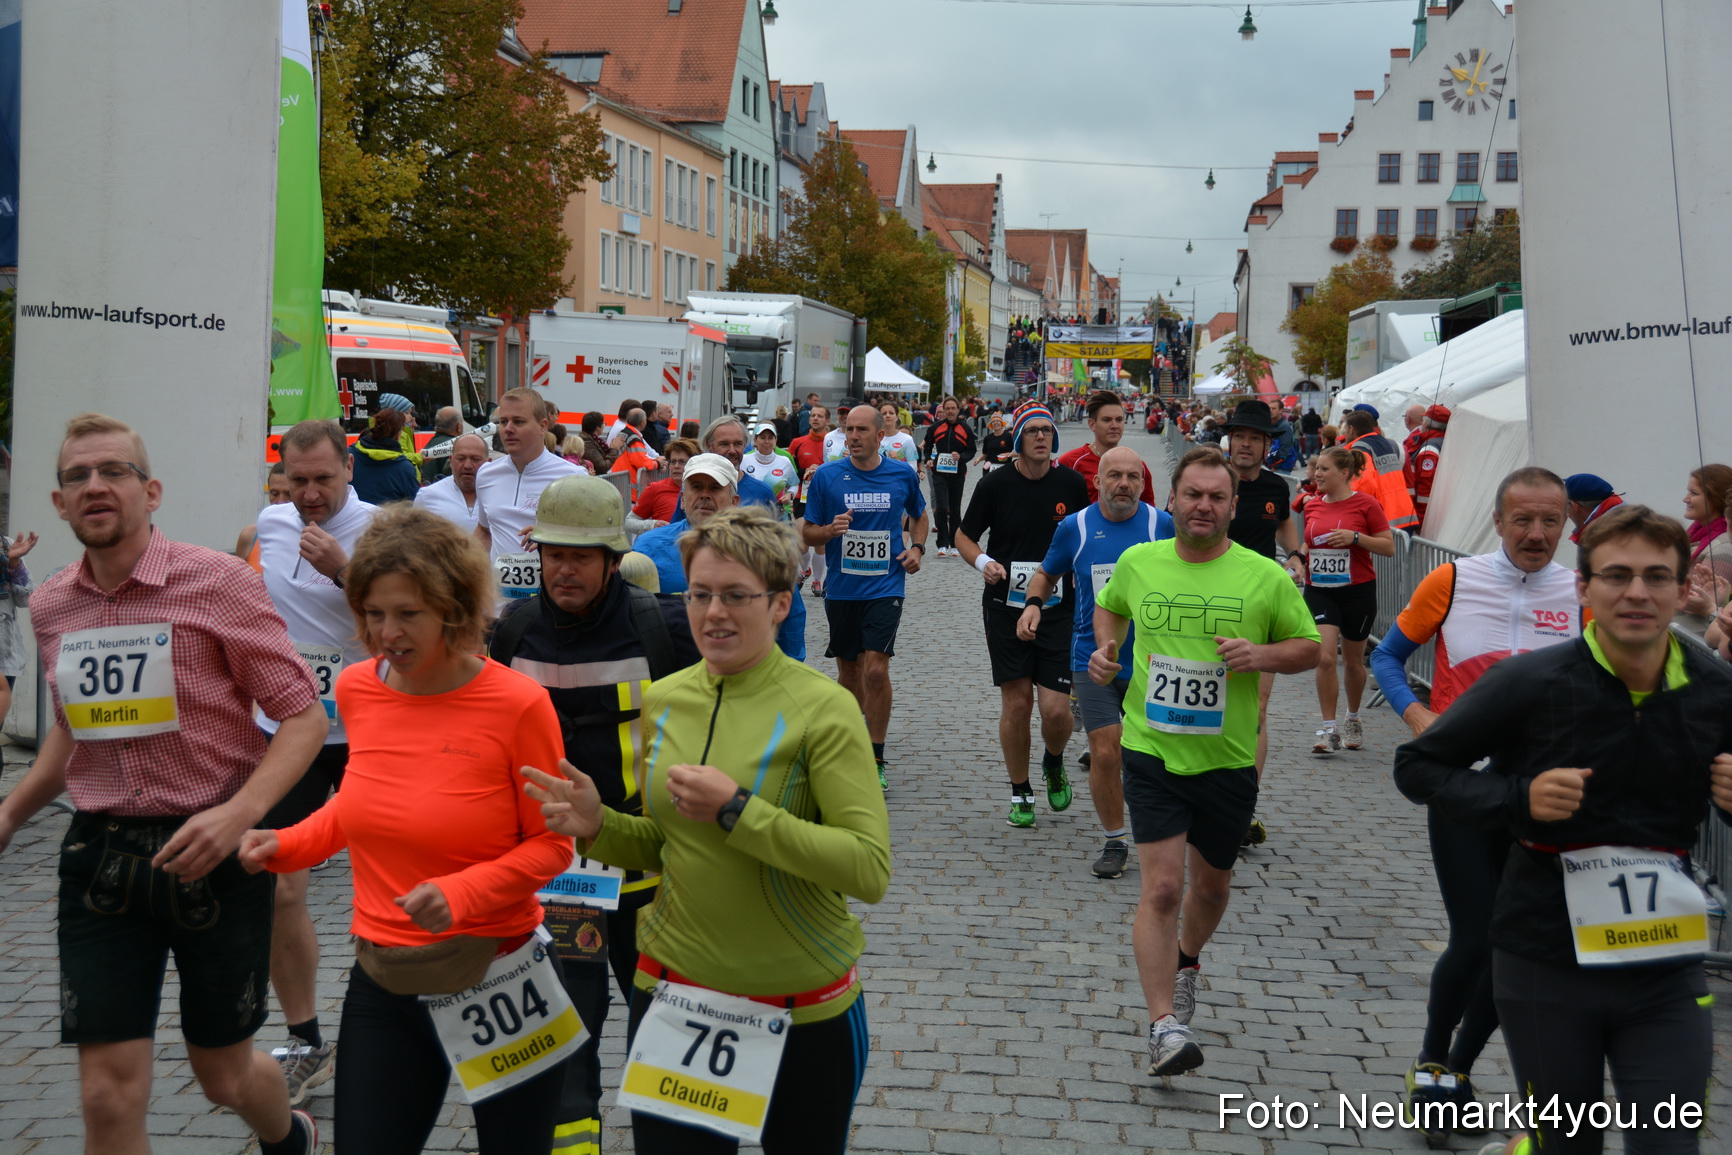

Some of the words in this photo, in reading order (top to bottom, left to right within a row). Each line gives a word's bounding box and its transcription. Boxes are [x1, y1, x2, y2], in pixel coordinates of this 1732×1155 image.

[21, 301, 226, 331] www.bmw-laufsport.de
[1569, 316, 1732, 346] www.bmw-lauf
[1080, 347, 1117, 356] START
[598, 356, 649, 367] Bayerisches
[598, 367, 622, 375] Rotes
[353, 379, 378, 393] Bayerisches
[597, 378, 621, 386] Kreuz
[868, 381, 902, 390] Laufsport
[355, 392, 367, 405] Rotes
[356, 407, 368, 418] Kreuz
[844, 493, 891, 503] HUBER
[846, 541, 886, 558] 2318
[851, 561, 880, 569] Willibald
[1313, 558, 1346, 573] 2430
[500, 566, 541, 586] 233
[1534, 630, 1570, 638] TECHNICAL-WEAR
[62, 641, 95, 653] PARTL
[98, 636, 151, 649] Neumarkt
[299, 651, 327, 661] umarkt
[79, 652, 148, 697] 367
[1151, 660, 1174, 671] PARTL
[1175, 666, 1213, 676] Neumarkt
[1153, 673, 1219, 707] 2133
[90, 706, 139, 724] Martin
[1168, 710, 1195, 724] Sepp
[1565, 858, 1608, 873] PARTL
[1611, 857, 1667, 867] Neumarkt
[1608, 871, 1659, 914] 17
[1605, 923, 1679, 946] Benedikt
[430, 989, 471, 1011] PARTL
[472, 961, 532, 995] Neumarkt
[461, 978, 550, 1046] 304
[698, 1002, 763, 1029] Neumarkt
[491, 1033, 556, 1073] Claudia
[681, 1019, 740, 1077] 76
[455, 1053, 462, 1062] D
[635, 1052, 642, 1061] D
[659, 1076, 729, 1112] Claudia
